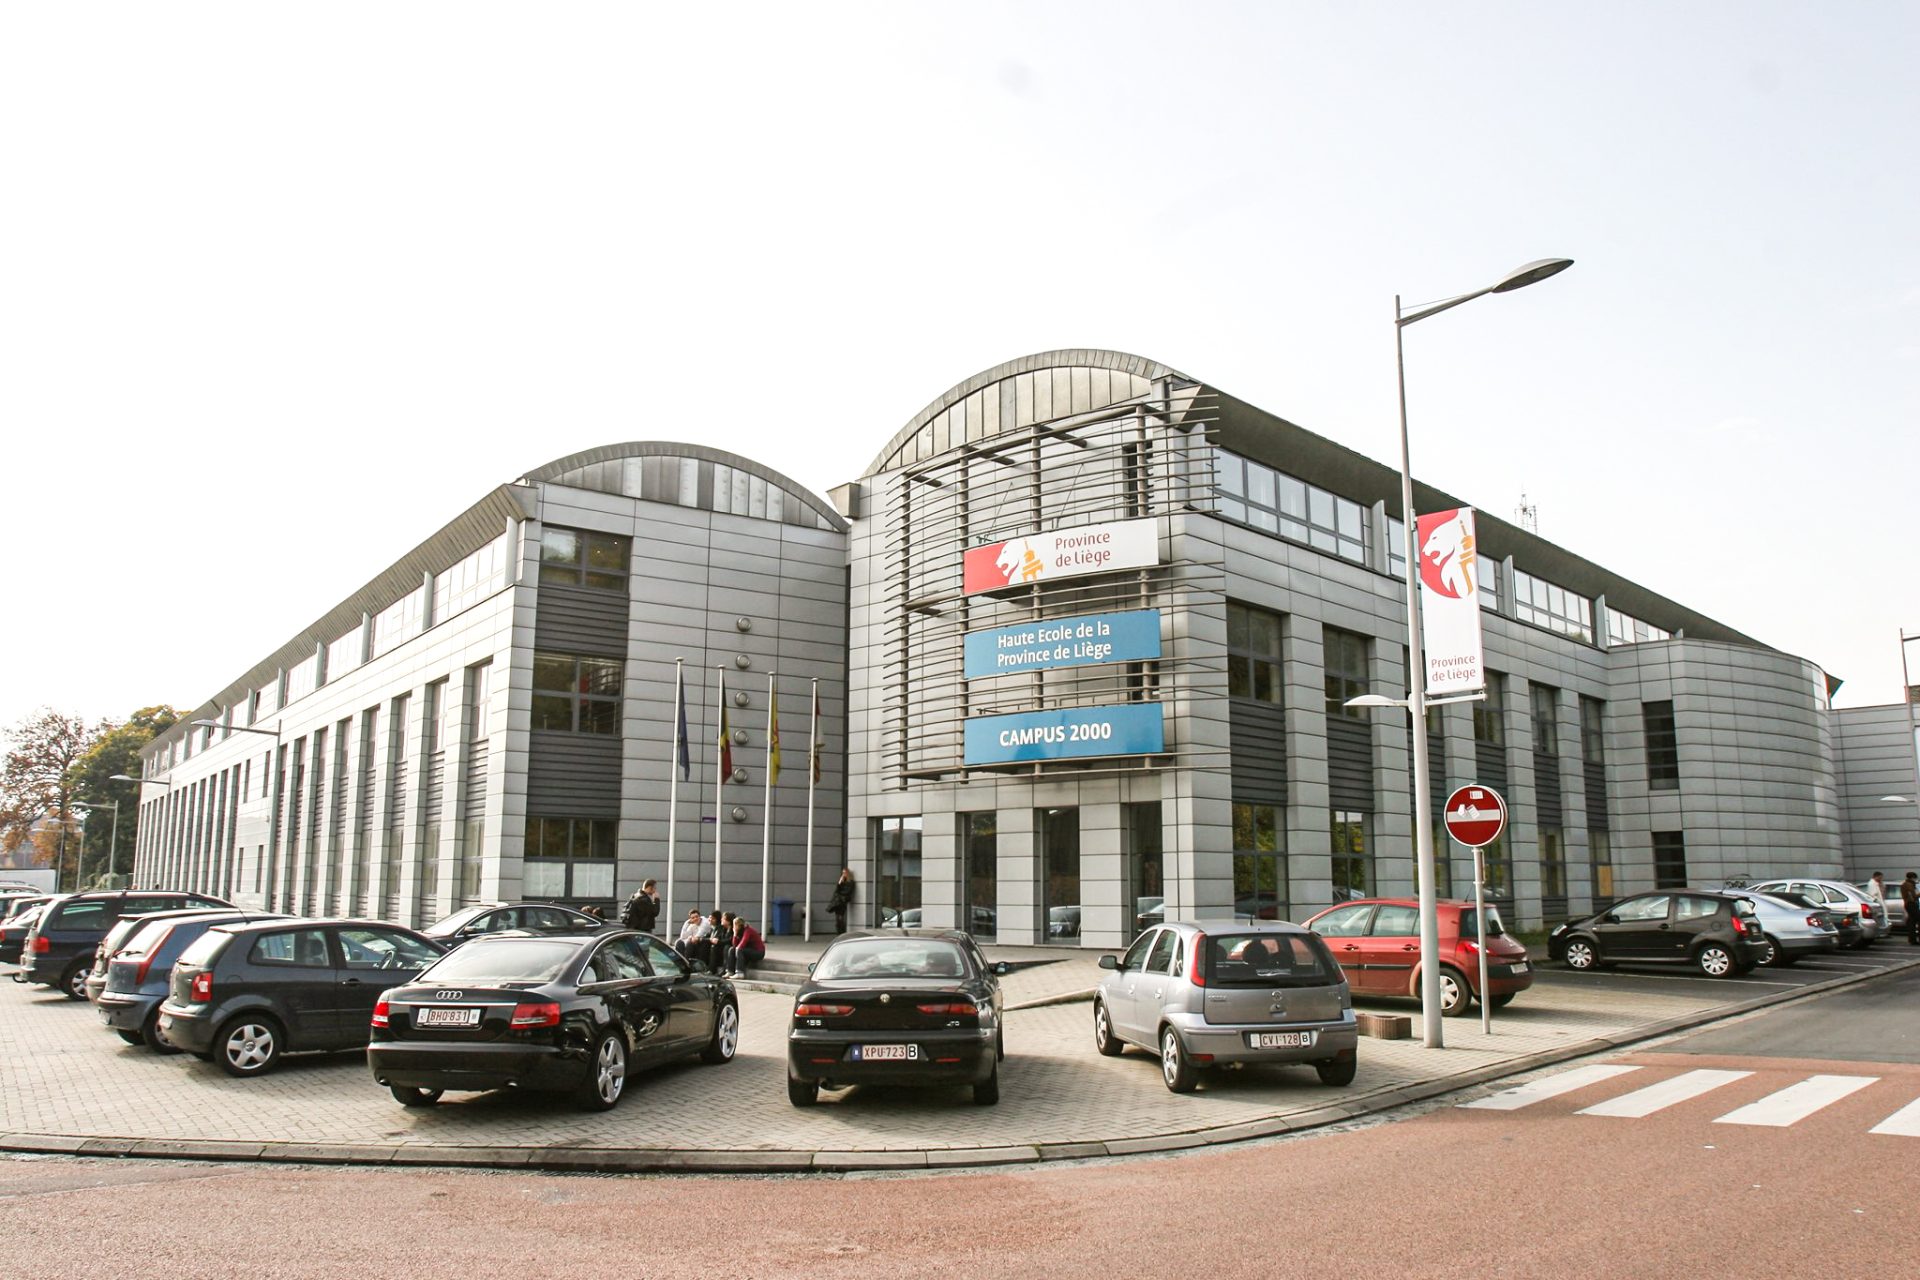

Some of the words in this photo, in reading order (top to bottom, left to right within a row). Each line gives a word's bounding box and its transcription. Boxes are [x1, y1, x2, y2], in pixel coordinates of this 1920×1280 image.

[1055, 532, 1110, 550] Province
[1055, 553, 1071, 567] de
[1074, 549, 1111, 567] Liège
[998, 632, 1035, 648] Haute
[1038, 625, 1073, 643] Ecole
[1075, 622, 1094, 638] de
[1097, 620, 1110, 636] la
[997, 649, 1050, 667] Province
[1053, 644, 1070, 660] de
[1074, 641, 1112, 659] Liège
[1431, 655, 1476, 669] Province
[1431, 671, 1445, 682] de
[999, 725, 1066, 747] CAMPUS
[1069, 722, 1111, 741] 2000
[1302, 1034, 1309, 1043] B
[908, 1045, 917, 1058] B
